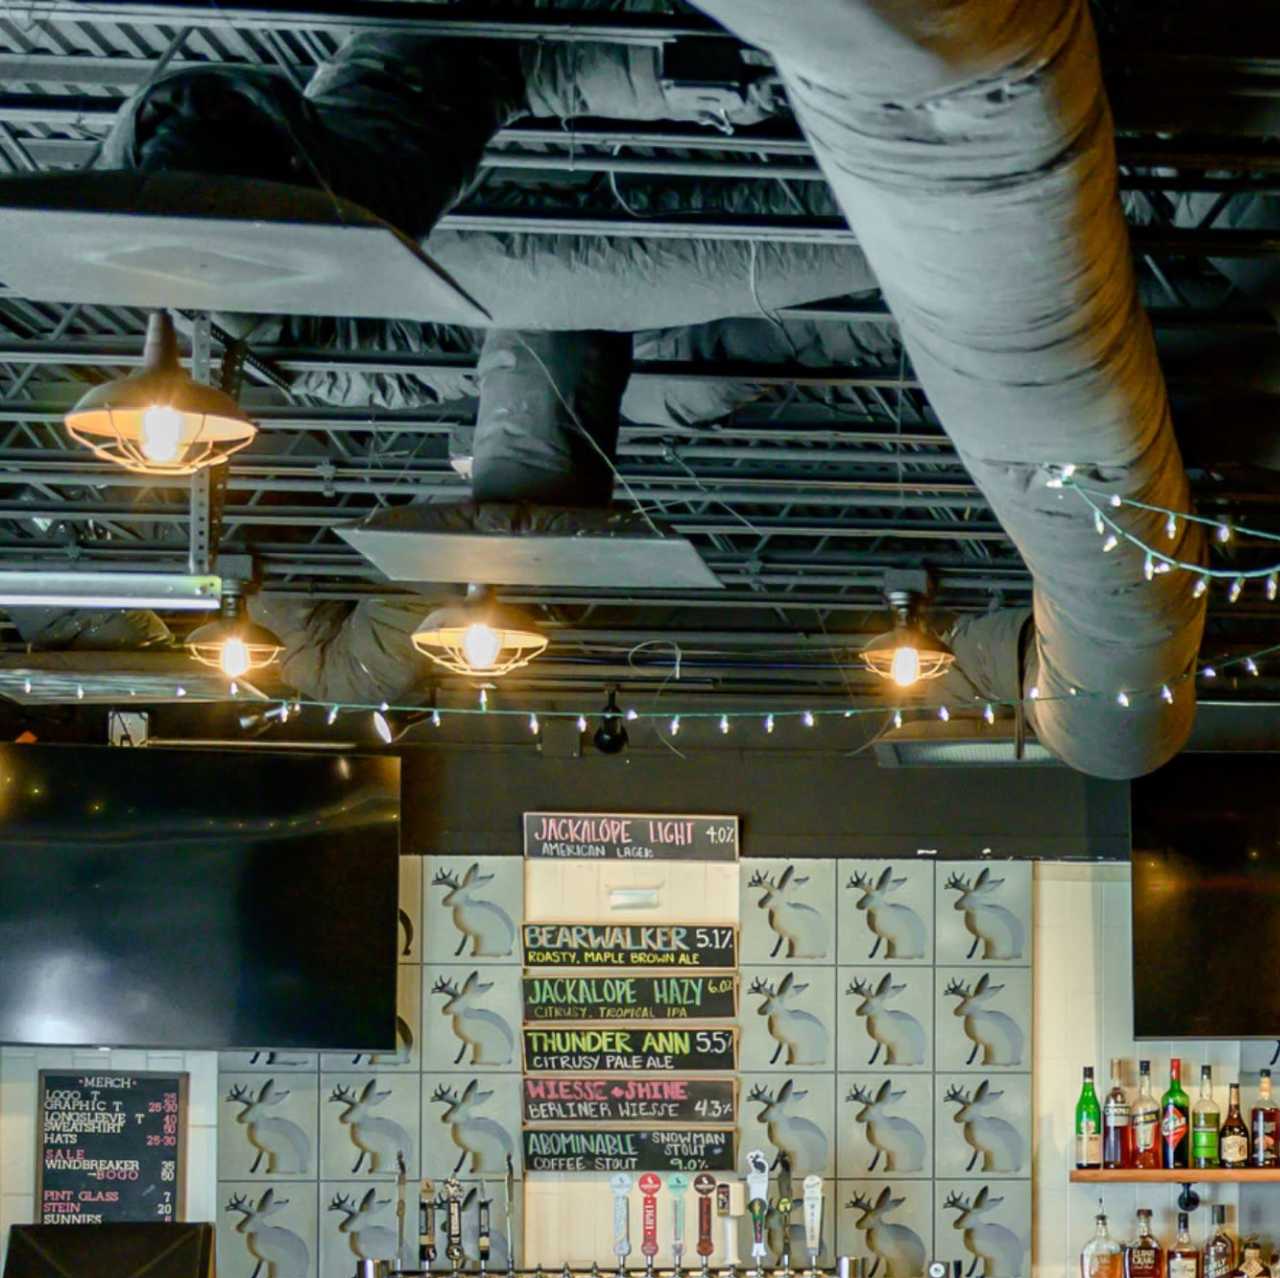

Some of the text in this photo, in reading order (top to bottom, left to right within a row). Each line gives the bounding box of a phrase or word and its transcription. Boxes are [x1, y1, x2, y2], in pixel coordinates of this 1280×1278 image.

[535, 818, 632, 843] JACKALOPE
[650, 820, 694, 845] LIGHT
[542, 843, 605, 857] AMERICAN
[525, 926, 733, 950] BEARWALKER 5.1%
[584, 952, 624, 964] MAPLE
[630, 952, 675, 963] BROWN
[678, 952, 700, 964] ALE
[528, 978, 637, 1004] JACKALOPE
[654, 978, 703, 1005] HAZY
[600, 1007, 654, 1018] TROPICAL
[667, 1007, 687, 1017] IPA
[527, 1032, 634, 1053] THUNDER
[642, 1032, 690, 1054] ANN
[533, 1055, 674, 1070] CITRUSY PALE ALE
[46, 1090, 80, 1100] LOGO
[90, 1091, 100, 1101] T
[44, 1100, 106, 1111] GRAPHIC
[112, 1101, 122, 1112] T
[528, 1103, 612, 1118] BERLINER
[619, 1103, 680, 1117] WIESSE
[135, 1113, 145, 1124] T
[44, 1121, 124, 1133] SWEATSHIRT
[44, 1133, 78, 1144] HATS
[528, 1133, 725, 1155] ABOMINABLE SNOWMAN
[664, 1145, 706, 1156] STOUT
[45, 1160, 140, 1170] WINDBREAKER
[534, 1157, 589, 1170] COFFEE
[595, 1157, 638, 1170] STOUT
[44, 1190, 73, 1201] PINT
[79, 1190, 119, 1201] GLASS
[43, 1203, 81, 1213] STEIN
